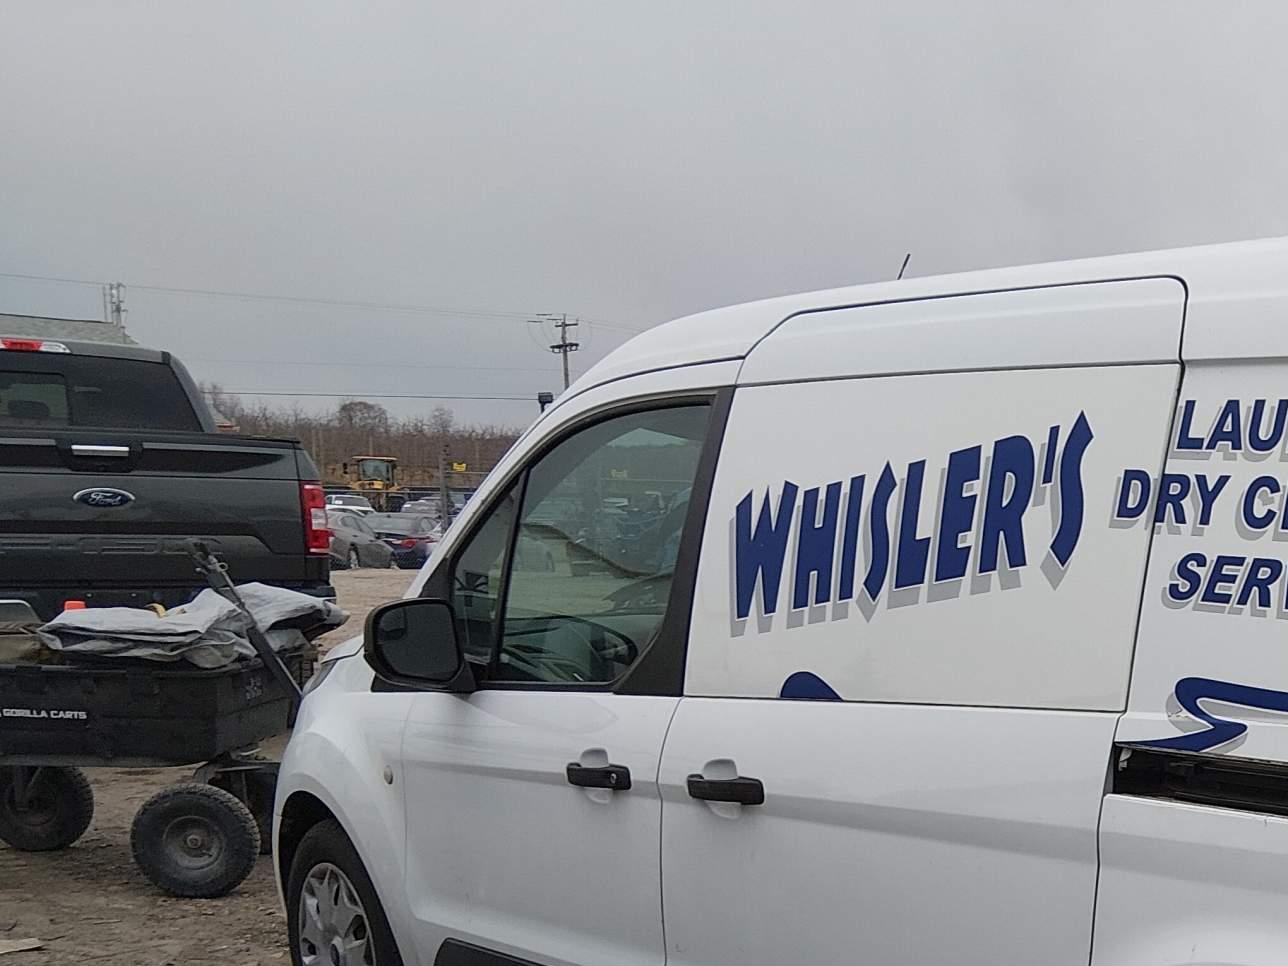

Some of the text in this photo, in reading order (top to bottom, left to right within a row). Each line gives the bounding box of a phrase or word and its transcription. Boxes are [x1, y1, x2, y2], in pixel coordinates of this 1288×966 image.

[736, 410, 1094, 620] WHISLER'S
[1116, 468, 1231, 526] DRY
[50, 710, 88, 719] CARTS
